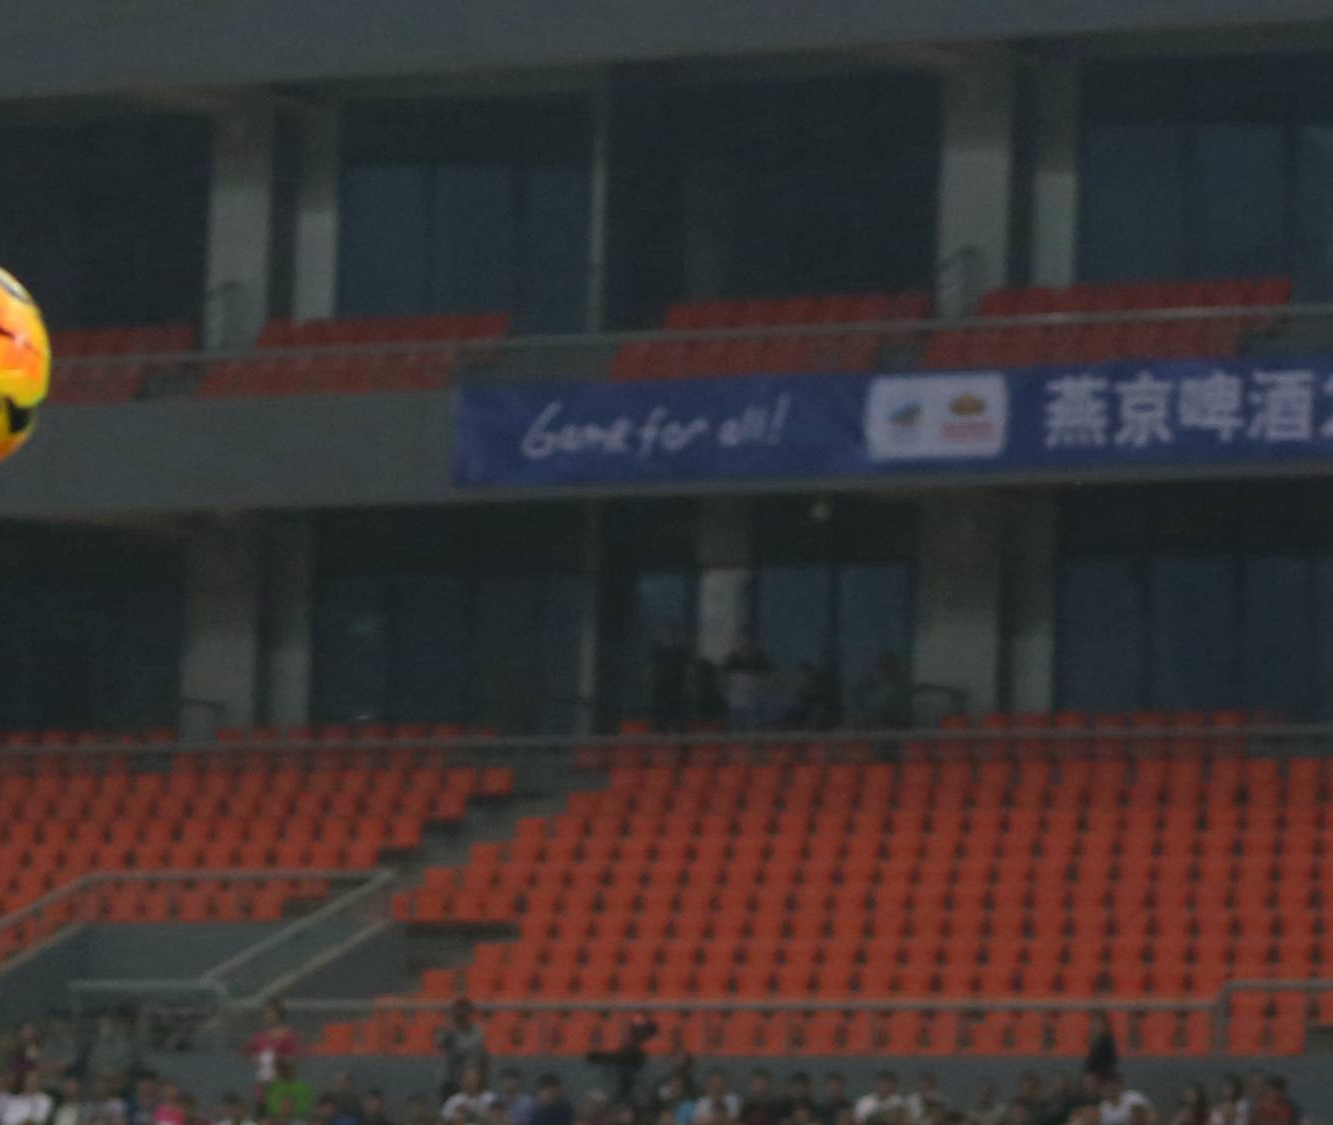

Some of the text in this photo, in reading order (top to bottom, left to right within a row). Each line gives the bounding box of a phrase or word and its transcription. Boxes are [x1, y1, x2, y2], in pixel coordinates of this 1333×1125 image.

[637, 405, 710, 458] for
[1044, 369, 1333, 449] 燕京啤酒
